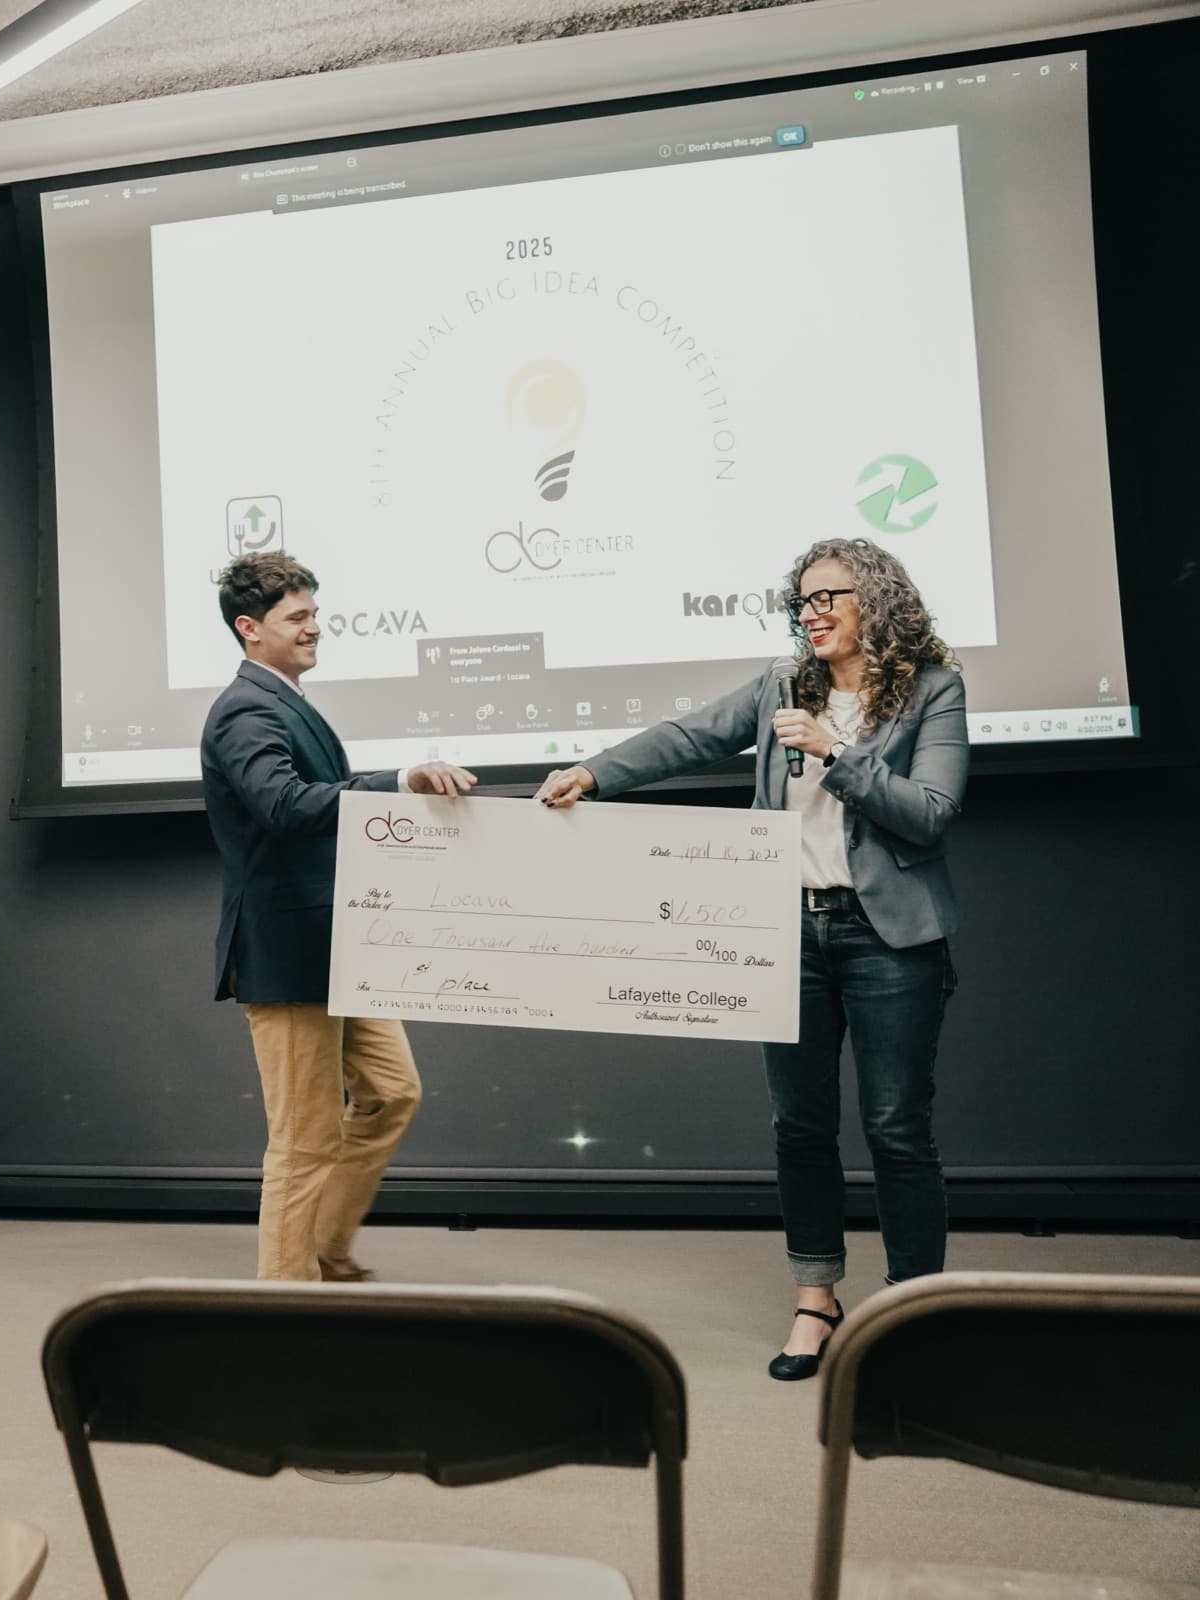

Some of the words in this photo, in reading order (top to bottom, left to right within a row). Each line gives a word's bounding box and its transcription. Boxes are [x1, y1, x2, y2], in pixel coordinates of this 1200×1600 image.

[688, 142, 711, 153] Don't
[711, 140, 733, 151] show
[749, 135, 773, 148] again
[782, 131, 799, 143] OK
[306, 189, 336, 202] meeting
[505, 237, 552, 261] 2025
[375, 312, 457, 432] ANNUAL
[465, 276, 517, 315] BIG
[533, 270, 600, 296] IDEA
[616, 285, 736, 481] COMPETITION
[576, 534, 634, 555] CENTER
[396, 824, 421, 837] DYER
[422, 825, 461, 839] CENTER
[750, 826, 769, 837] 003
[649, 846, 672, 857] Date
[366, 887, 383, 899] Pay
[347, 899, 360, 908] the
[360, 898, 382, 909] Order
[382, 901, 394, 912] of
[366, 917, 415, 945] One
[743, 955, 775, 968] Dollars
[434, 969, 493, 999] place
[608, 984, 682, 1006] Lafayette
[686, 989, 749, 1010] College
